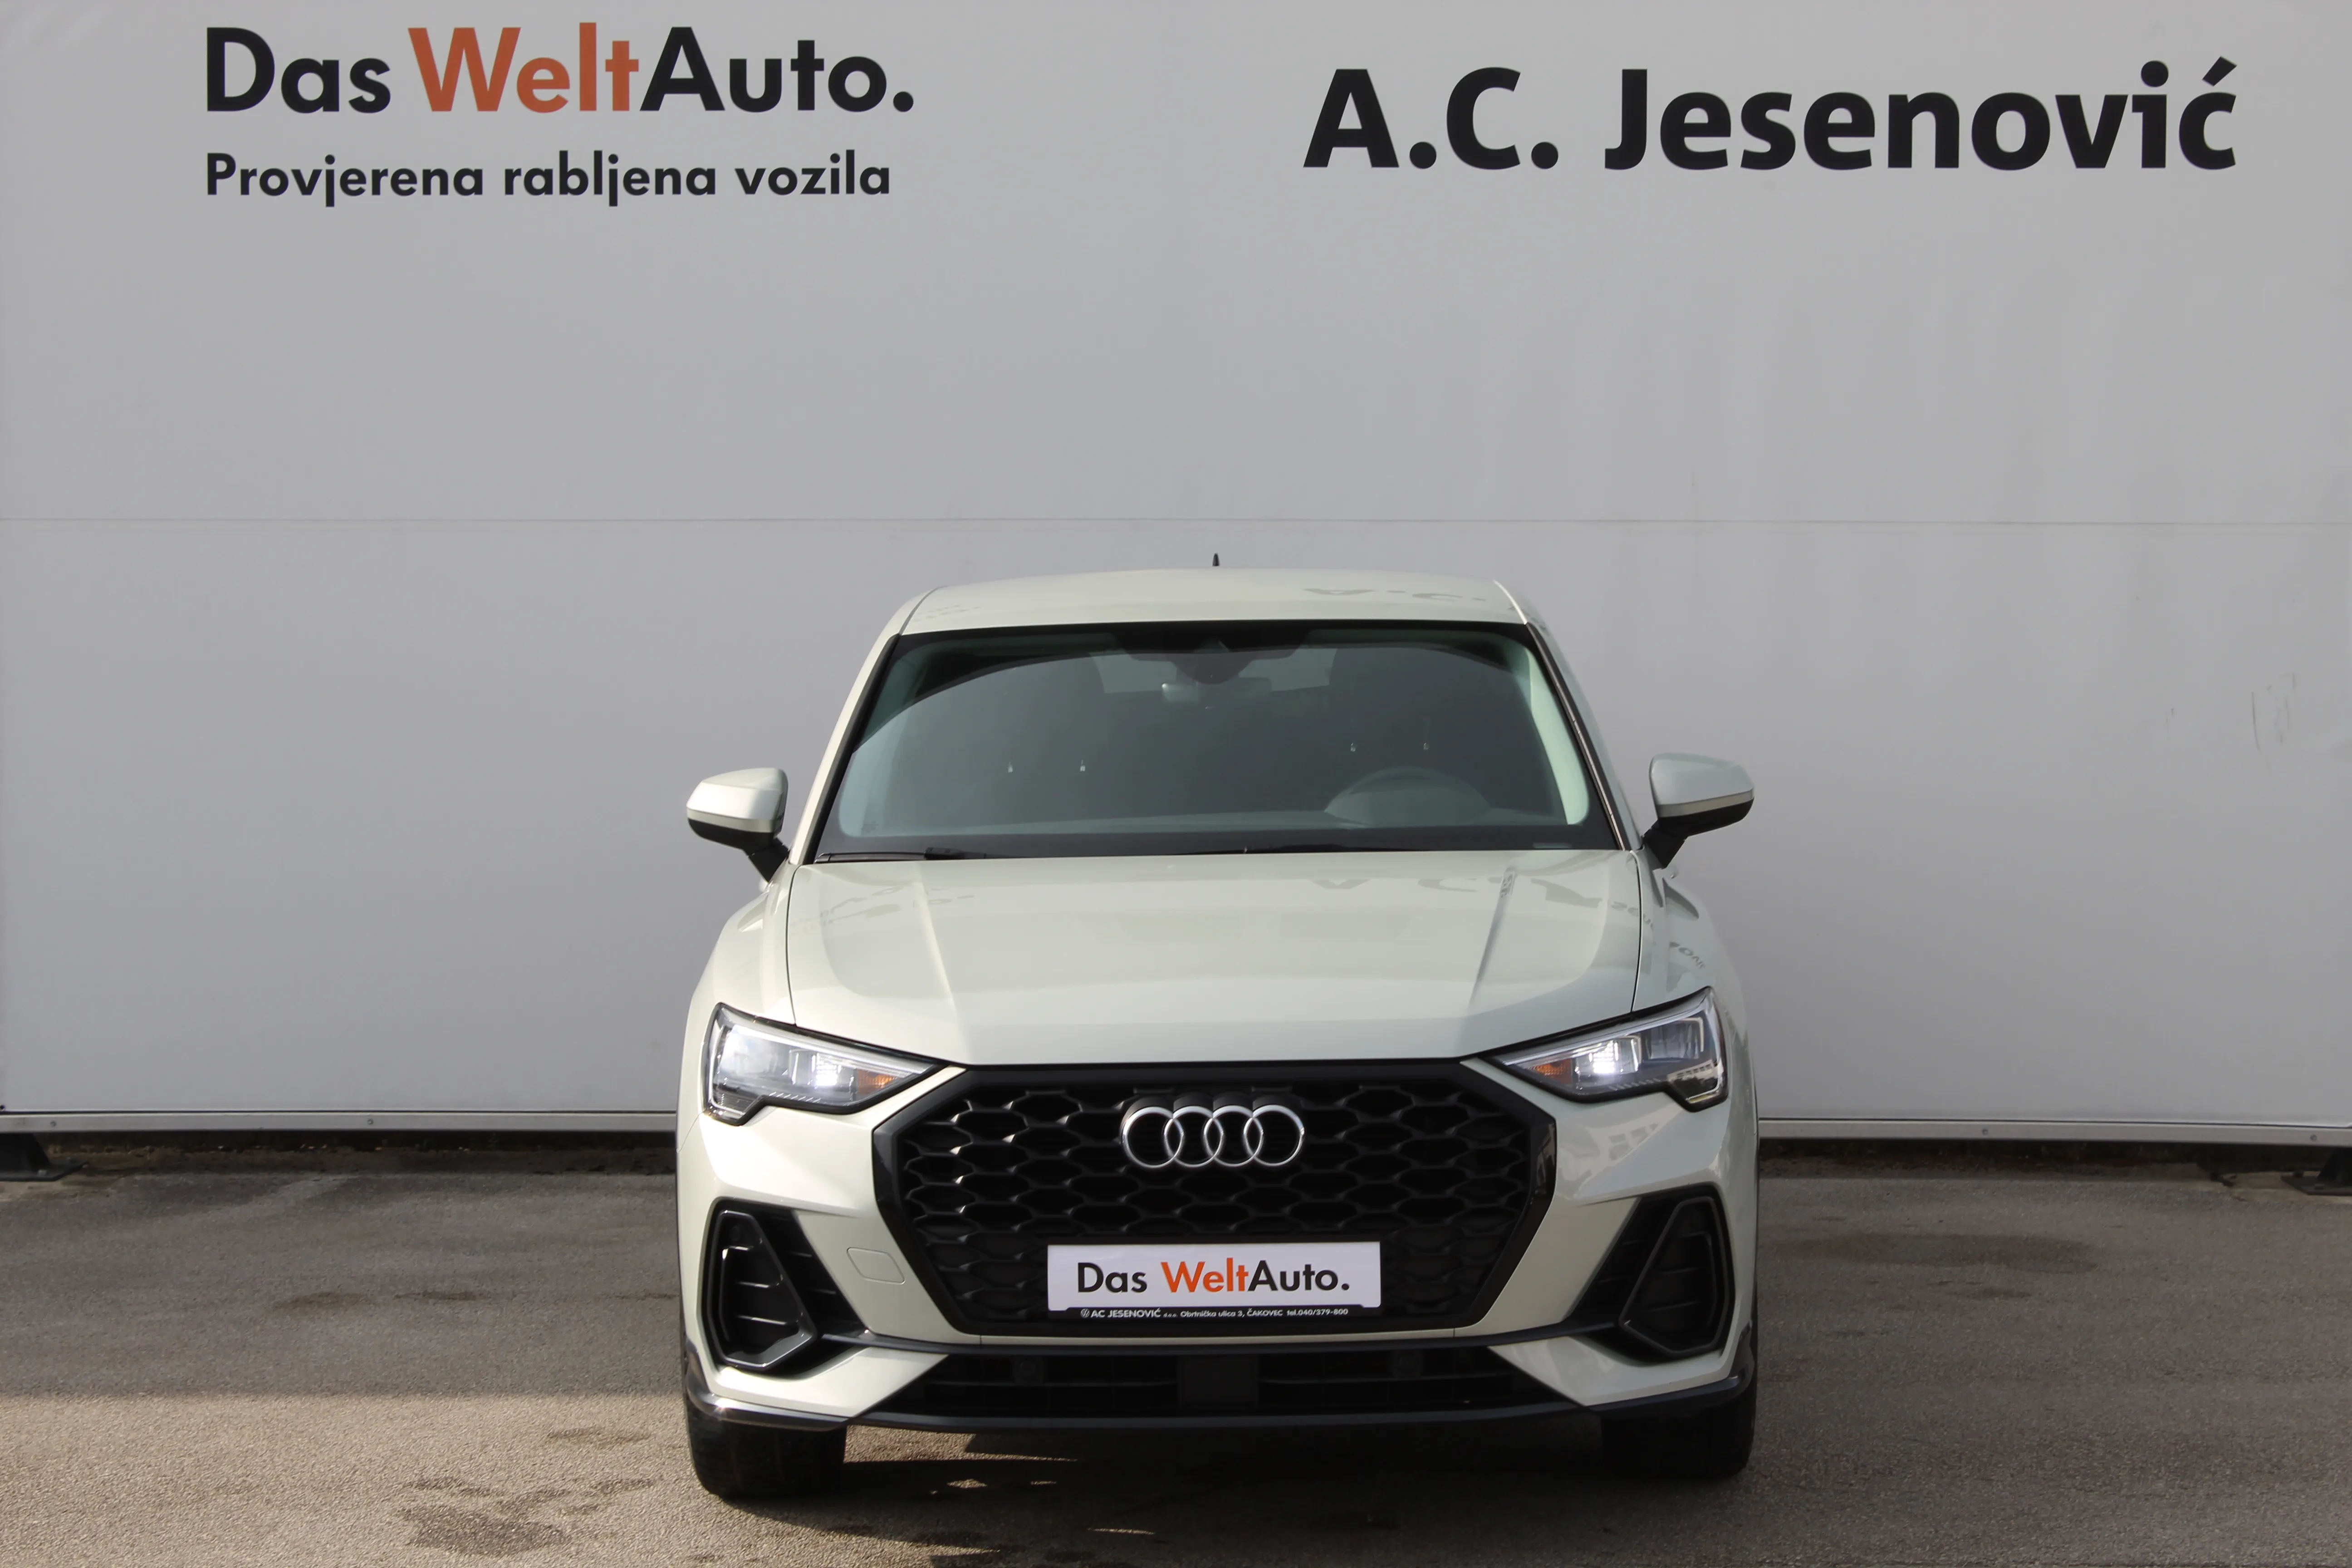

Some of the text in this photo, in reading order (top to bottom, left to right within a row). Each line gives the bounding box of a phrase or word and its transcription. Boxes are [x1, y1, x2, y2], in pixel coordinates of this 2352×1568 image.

[207, 22, 914, 113] Das WeltAuto.
[1303, 56, 2237, 171] A.C. Jesenović
[206, 150, 890, 207] Provjerena rabljena vozila
[1078, 1257, 1350, 1293] Das WeltAuto.
[1090, 1309, 1105, 1318] AC
[1107, 1308, 1161, 1318] JESENOVIĆ
[1247, 1308, 1284, 1317] ČAKOVEC
